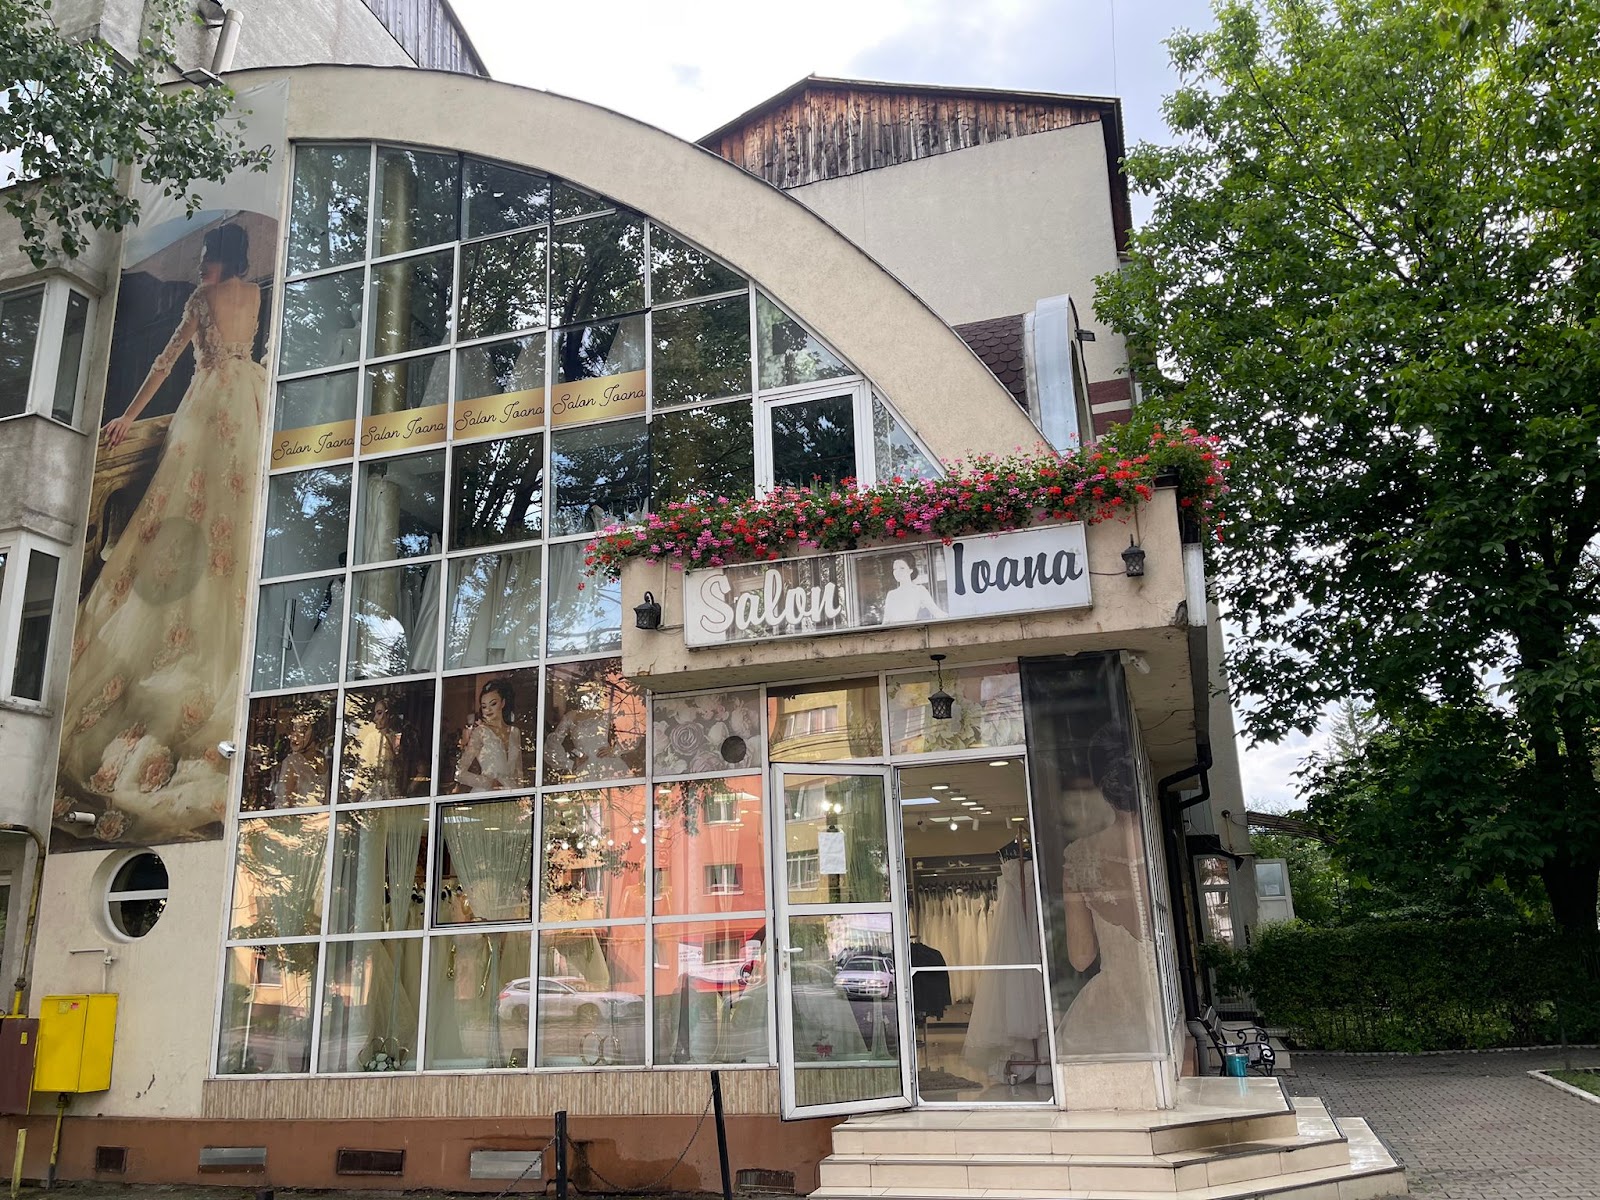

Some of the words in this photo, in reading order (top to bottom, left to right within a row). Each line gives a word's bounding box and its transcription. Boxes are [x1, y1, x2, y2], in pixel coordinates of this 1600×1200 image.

[552, 393, 597, 415] Salon
[454, 410, 497, 431] Salon
[360, 426, 401, 447] Salon
[272, 440, 312, 461] Salon
[699, 568, 842, 634] Salon
[952, 542, 1083, 596] Ioana
